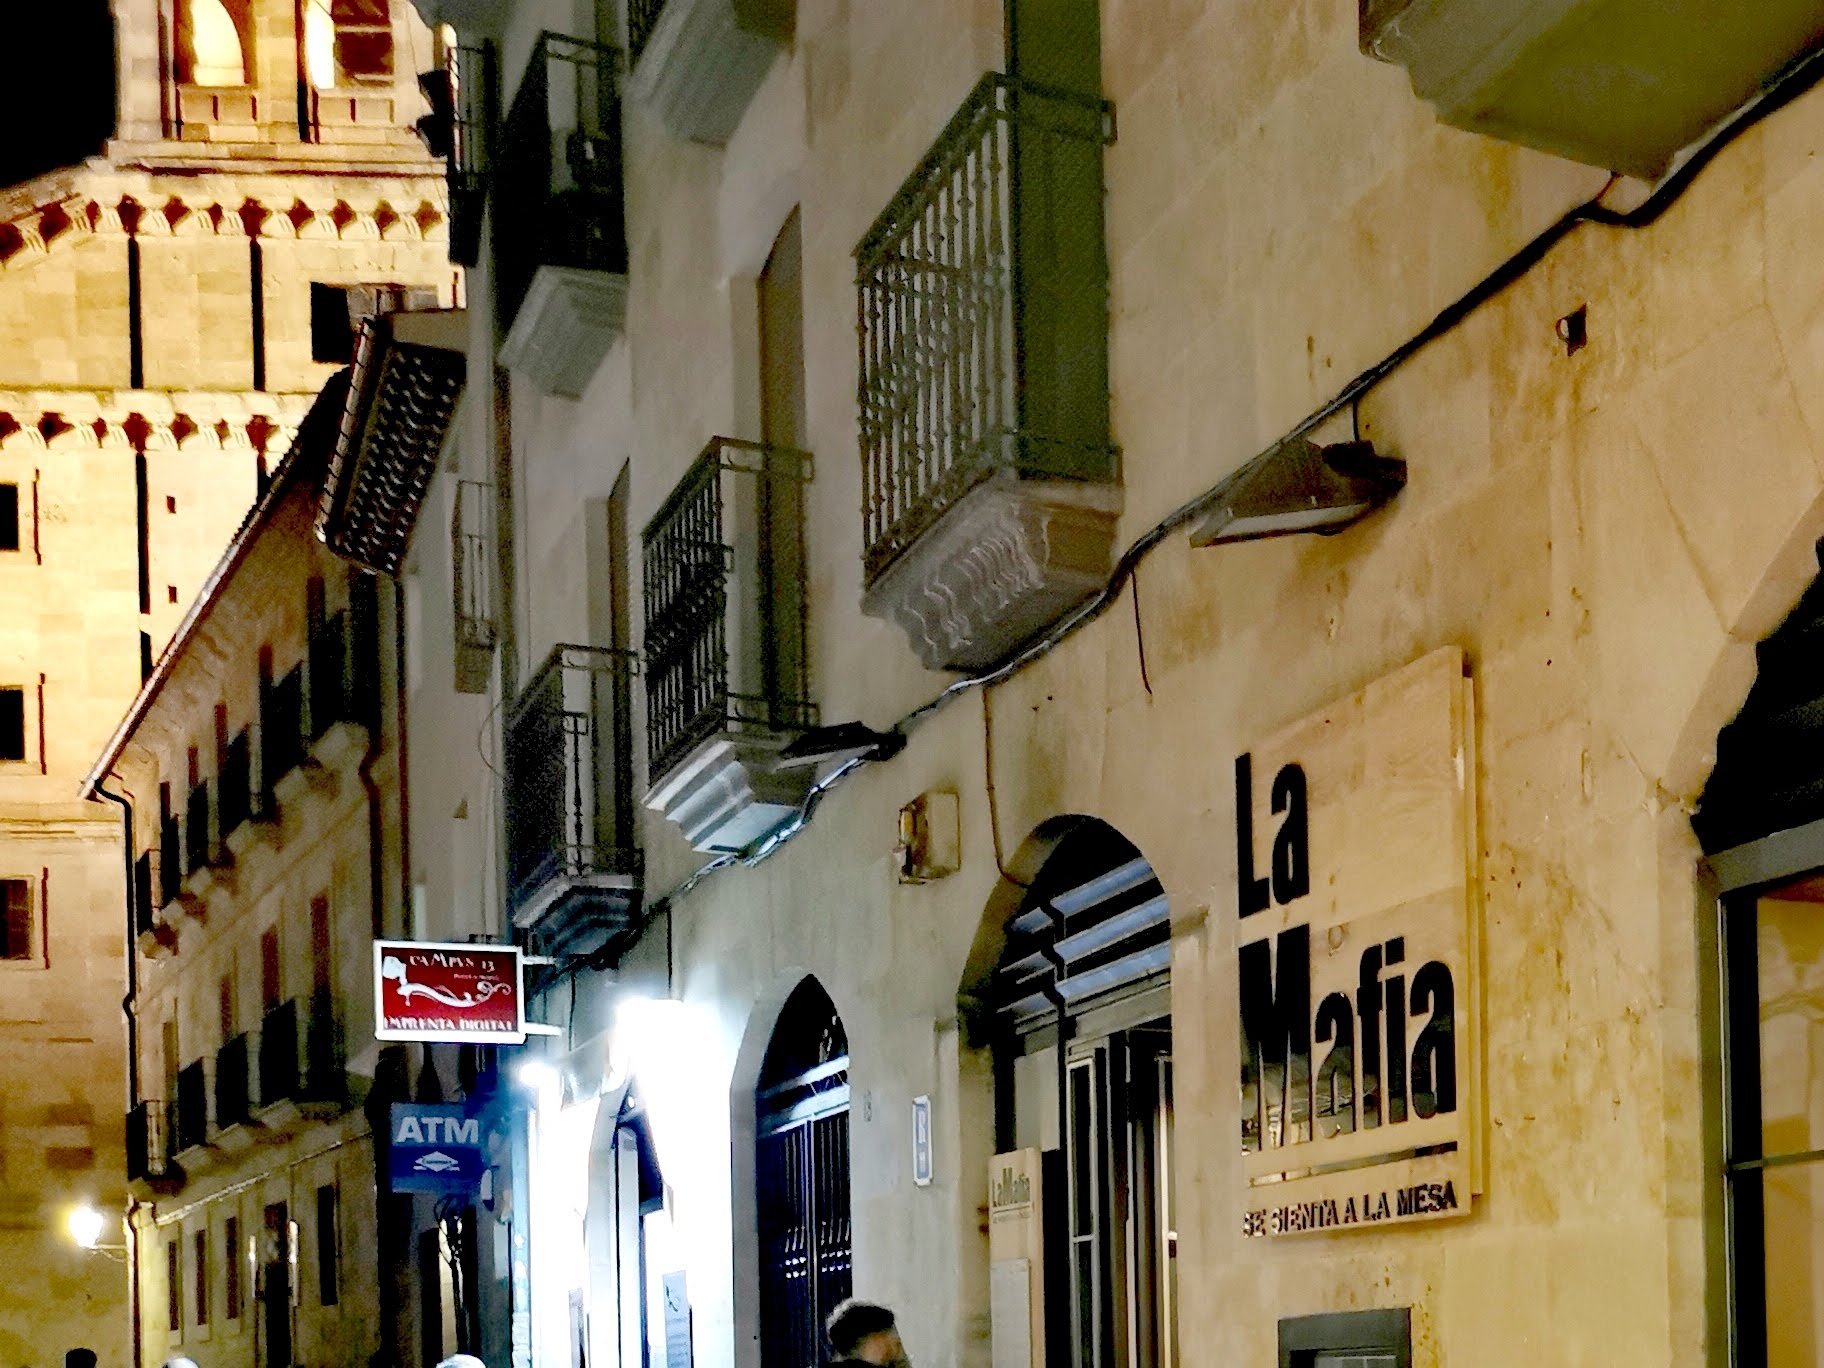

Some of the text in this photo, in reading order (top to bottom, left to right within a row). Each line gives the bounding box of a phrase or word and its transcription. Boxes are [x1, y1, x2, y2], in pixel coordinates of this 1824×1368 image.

[1235, 752, 1310, 920] La
[1238, 923, 1457, 1157] Mafia
[396, 1116, 479, 1144] ATM
[1242, 1180, 1458, 1239] SE SIENTA A LA MESA
